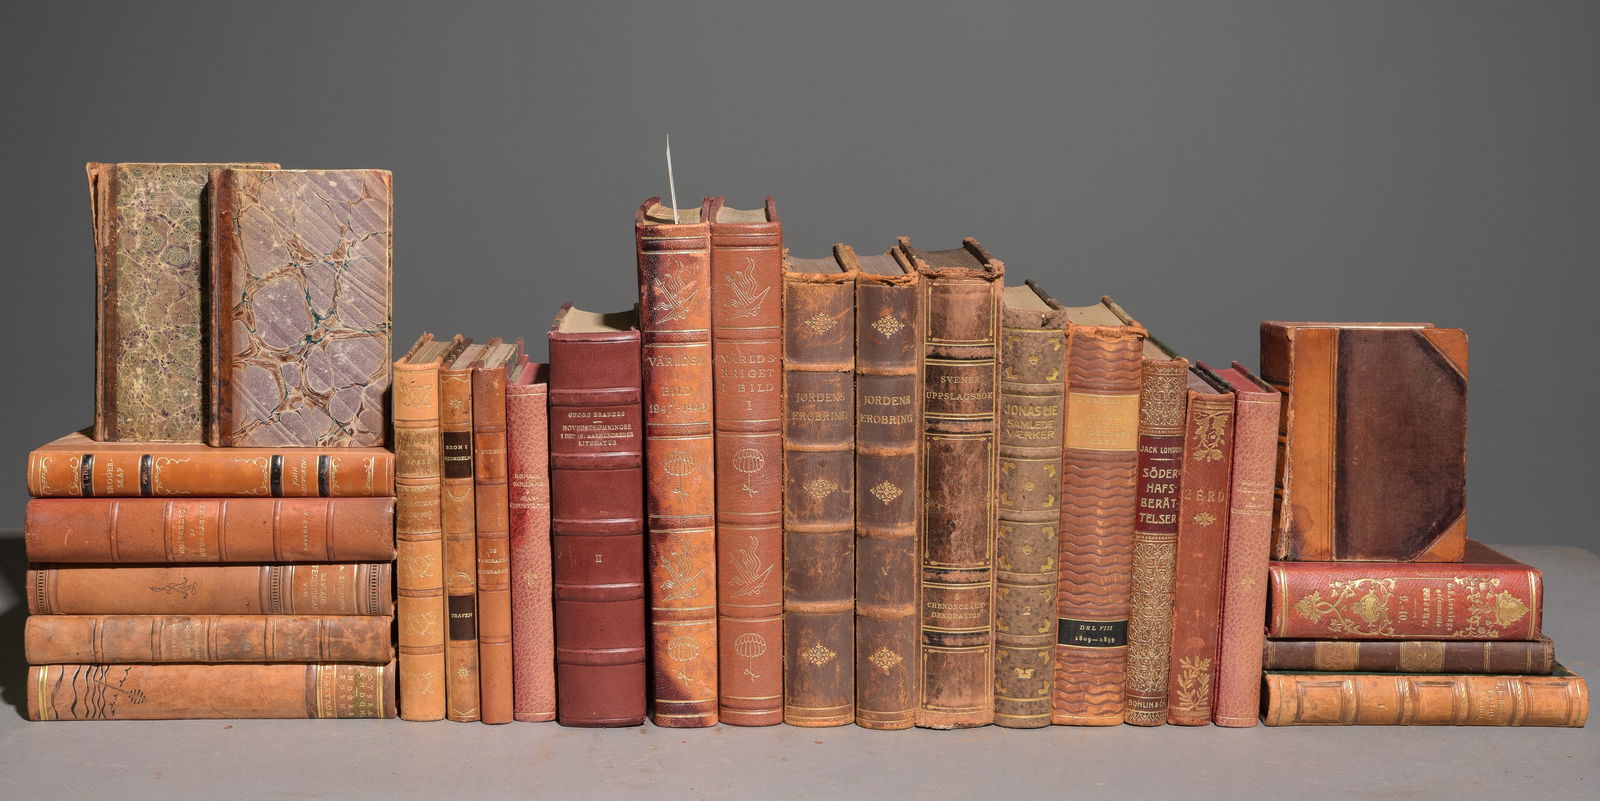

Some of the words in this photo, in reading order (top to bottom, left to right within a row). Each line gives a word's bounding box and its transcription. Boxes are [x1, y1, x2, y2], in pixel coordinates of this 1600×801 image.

[940, 375, 981, 384] SVENSK
[738, 383, 774, 393] BILD
[795, 392, 846, 403] JORDENS
[863, 395, 911, 406] JORDENS
[926, 391, 993, 401] UPPSLAGSBOK
[791, 411, 848, 421] EROBRING
[1004, 404, 1042, 417] JONAS
[1043, 405, 1059, 416] LIE
[860, 413, 913, 425] EROBRING
[1007, 419, 1054, 430] SAMLEDE
[1006, 429, 1055, 440] VÆRKER
[1140, 445, 1158, 454] JACK
[1160, 446, 1182, 454] LONDON
[116, 467, 124, 488] SKAP
[1142, 466, 1181, 479] SÖDER-
[1146, 483, 1177, 494] HAFS-
[1140, 497, 1180, 509] BERÄT-
[1138, 512, 1177, 524] TELSER
[954, 593, 960, 601] 6
[451, 611, 473, 619] TRAVEN
[931, 611, 981, 619] DEKORATION
[1022, 605, 1031, 616] 2
[1128, 699, 1155, 709] BOHLIN
